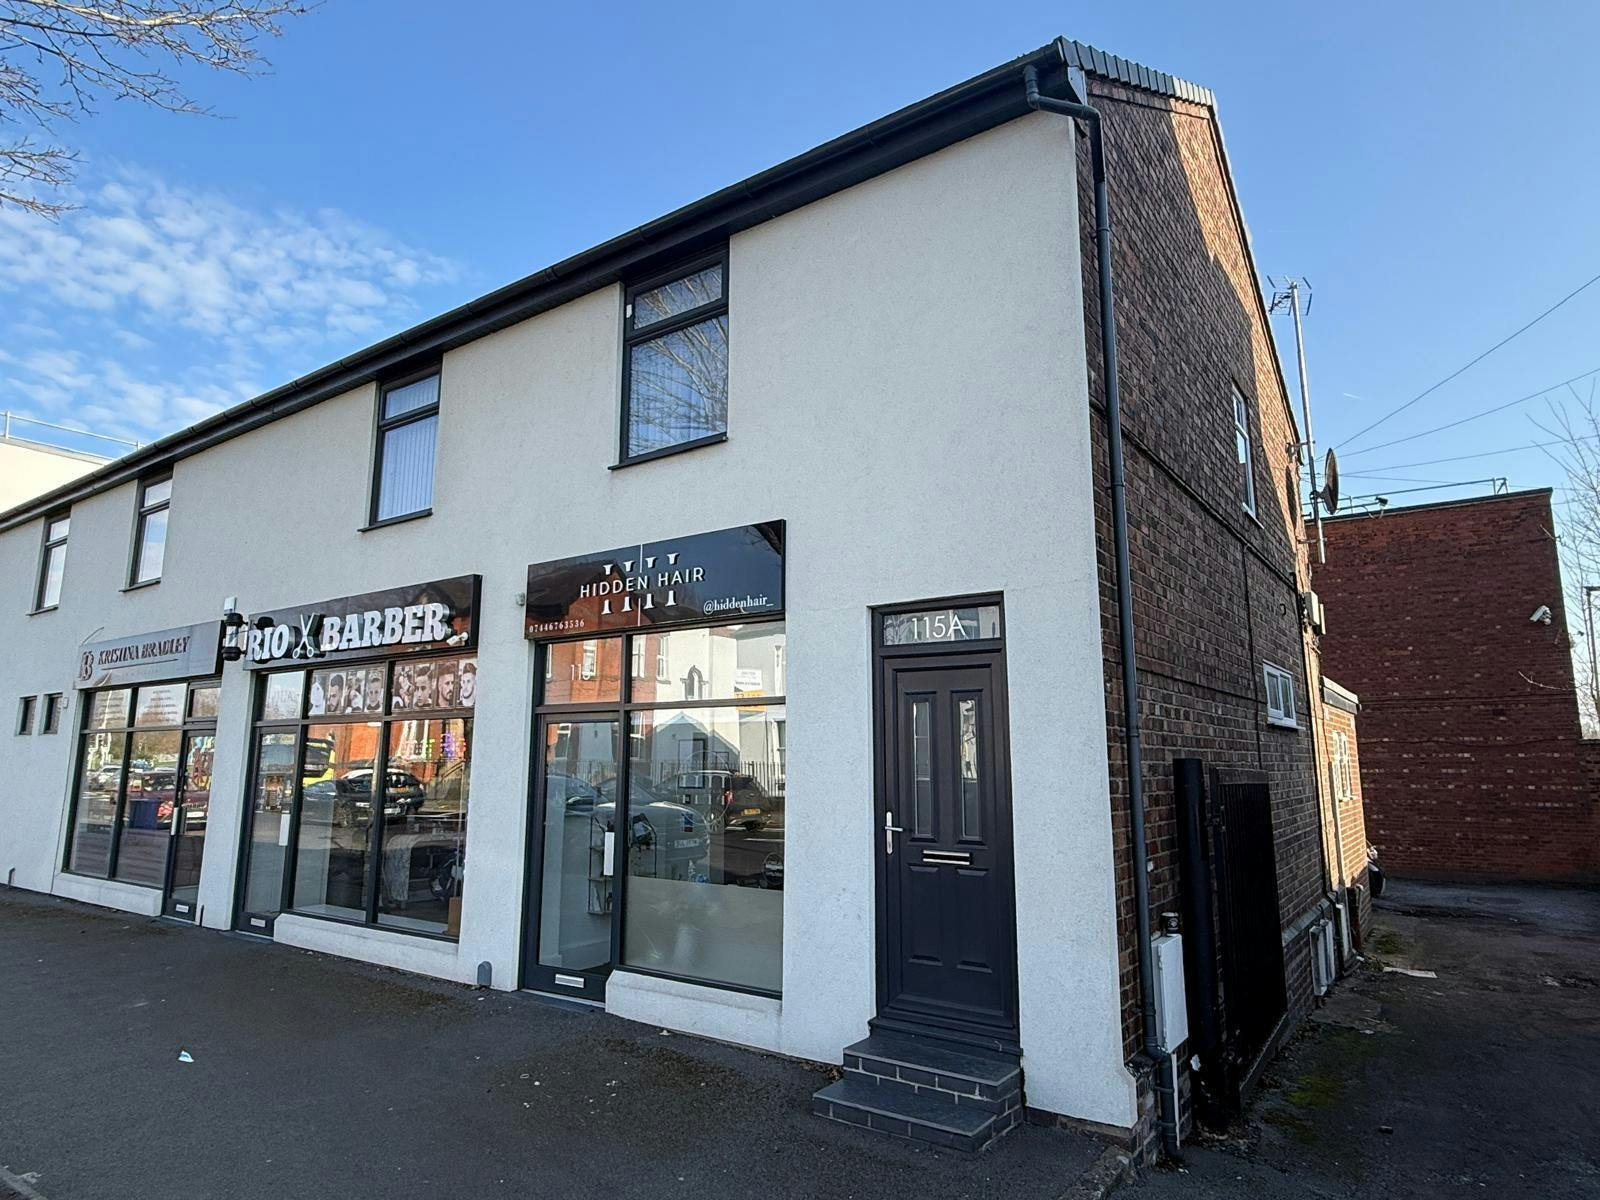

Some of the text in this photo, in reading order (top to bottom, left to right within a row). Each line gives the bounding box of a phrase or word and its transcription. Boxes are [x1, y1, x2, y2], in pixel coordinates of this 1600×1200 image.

[580, 567, 706, 599] HIDDEN HAIR
[246, 603, 447, 661] RIO BARBER
[911, 614, 966, 640] 115A
[98, 635, 191, 666] KRISTINA BRADLEY
